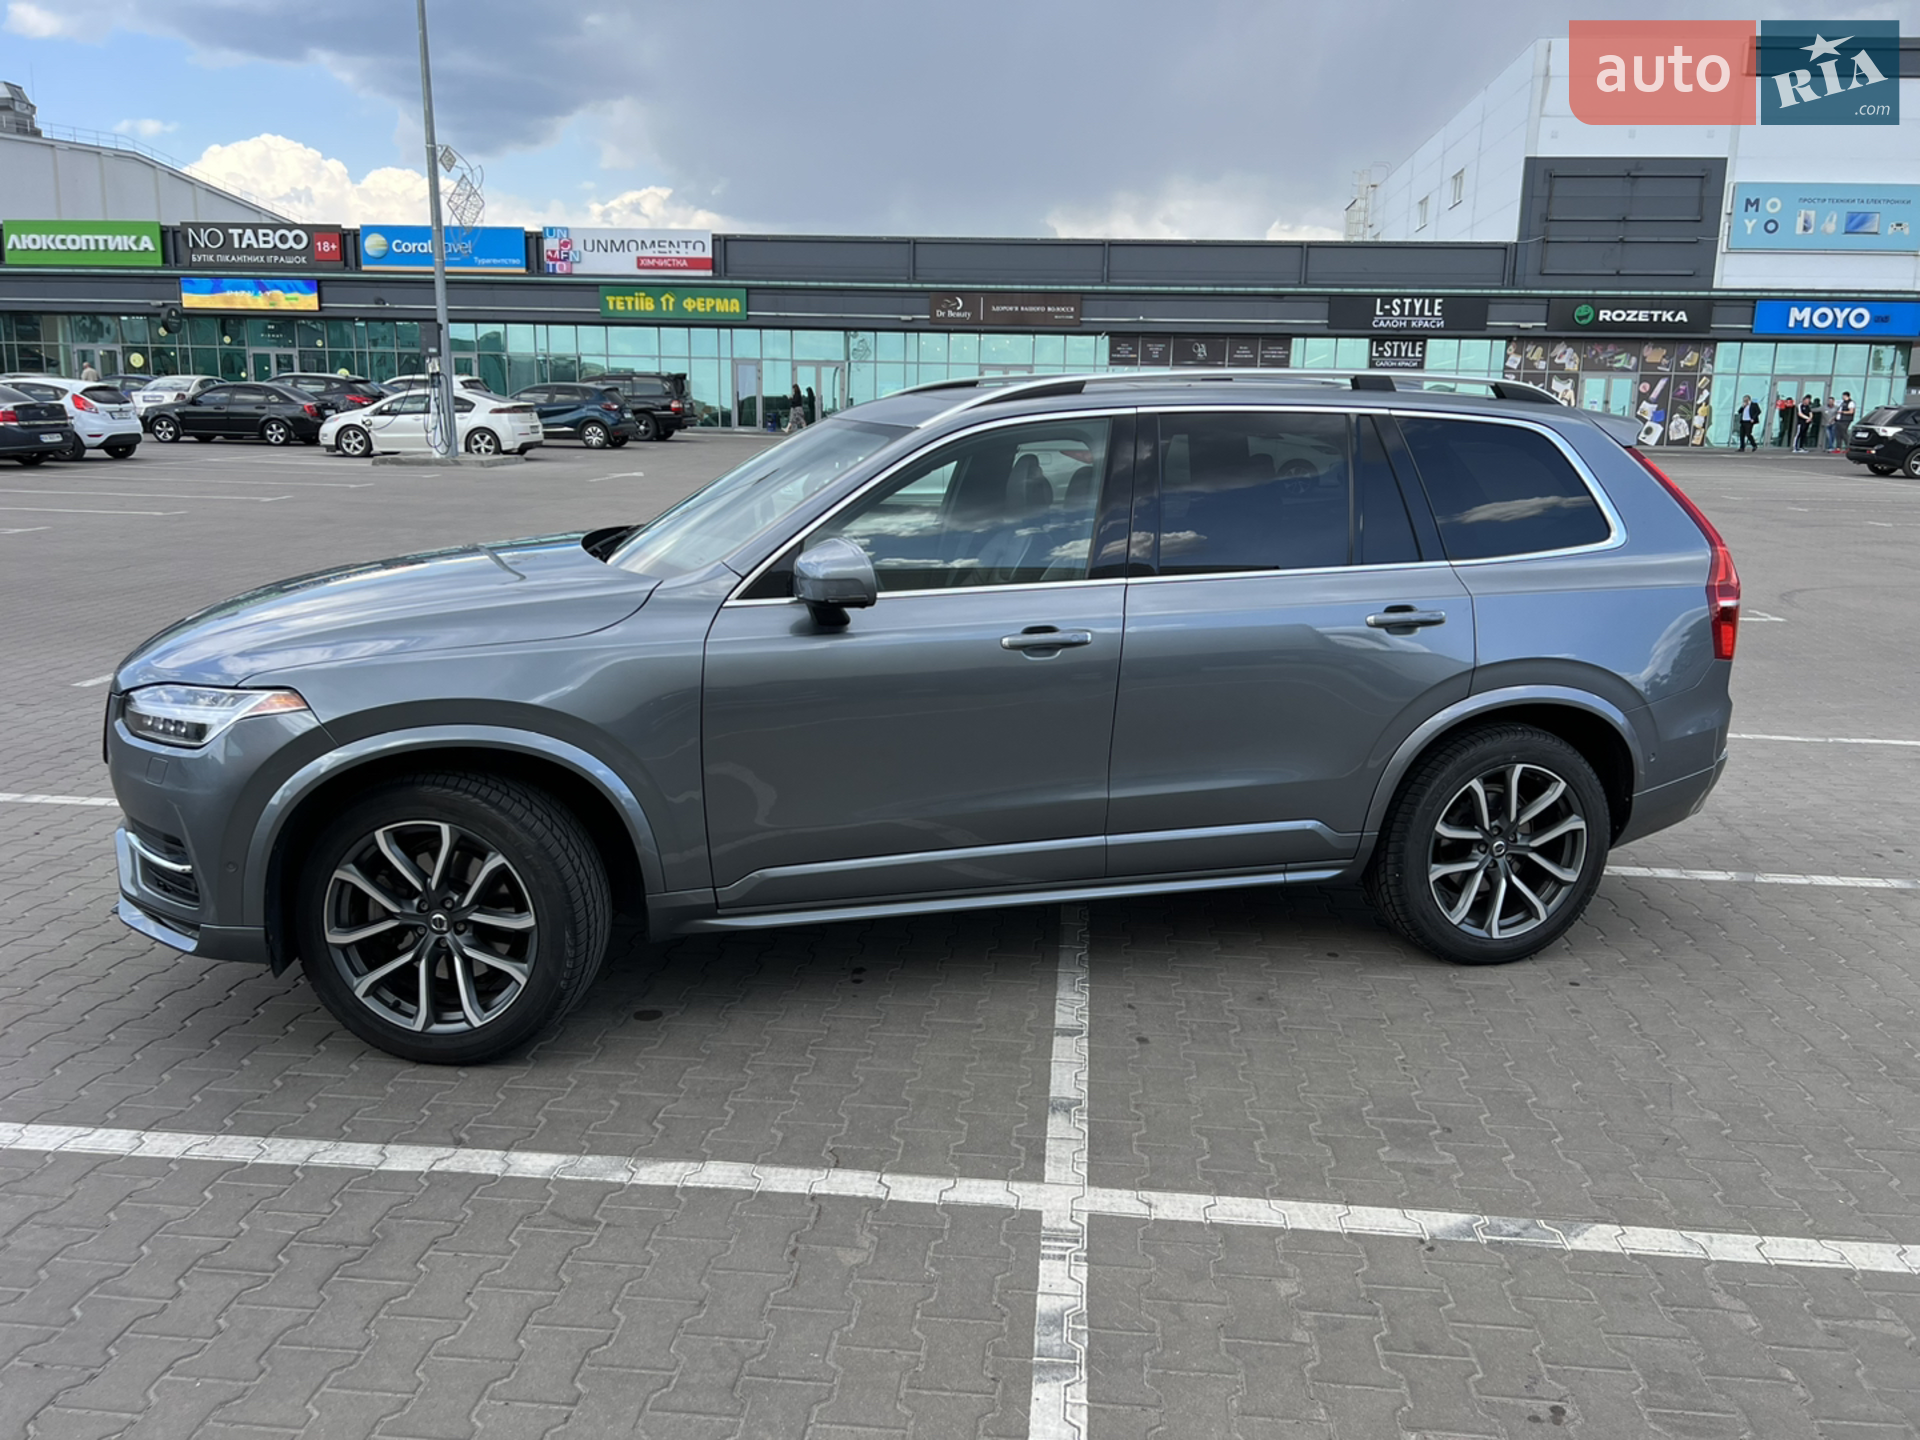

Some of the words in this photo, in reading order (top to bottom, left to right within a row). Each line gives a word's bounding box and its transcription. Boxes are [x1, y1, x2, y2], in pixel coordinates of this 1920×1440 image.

[1827, 197, 1856, 205] ТЕХНІКИ
[1866, 198, 1912, 206] ЕЛЕКТРОНІКИ
[7, 233, 156, 252] ЛЮКСОПТИКА
[187, 227, 224, 248] NO
[228, 228, 309, 251] TABOO
[315, 241, 338, 253] 18+
[391, 239, 433, 254] Coral
[583, 238, 706, 255] UNMOMENTO
[191, 253, 215, 263] БУТІК
[216, 254, 265, 264] ПІКАНТНИХ
[266, 255, 308, 265] ІГРАШОК
[473, 256, 521, 266] Турагентство
[639, 258, 688, 268] ХІМЧИСТКА
[682, 297, 741, 313] ФЕРМА
[1375, 298, 1444, 316] L-STYLE
[935, 309, 945, 318] Dr
[947, 310, 972, 321] Beauty
[1598, 309, 1688, 323] ROZETKA
[1788, 306, 1871, 329] MOYO
[1372, 319, 1407, 328] САЛОН
[1411, 319, 1445, 329] КРАСИ
[1371, 341, 1424, 358] L-STYLE
